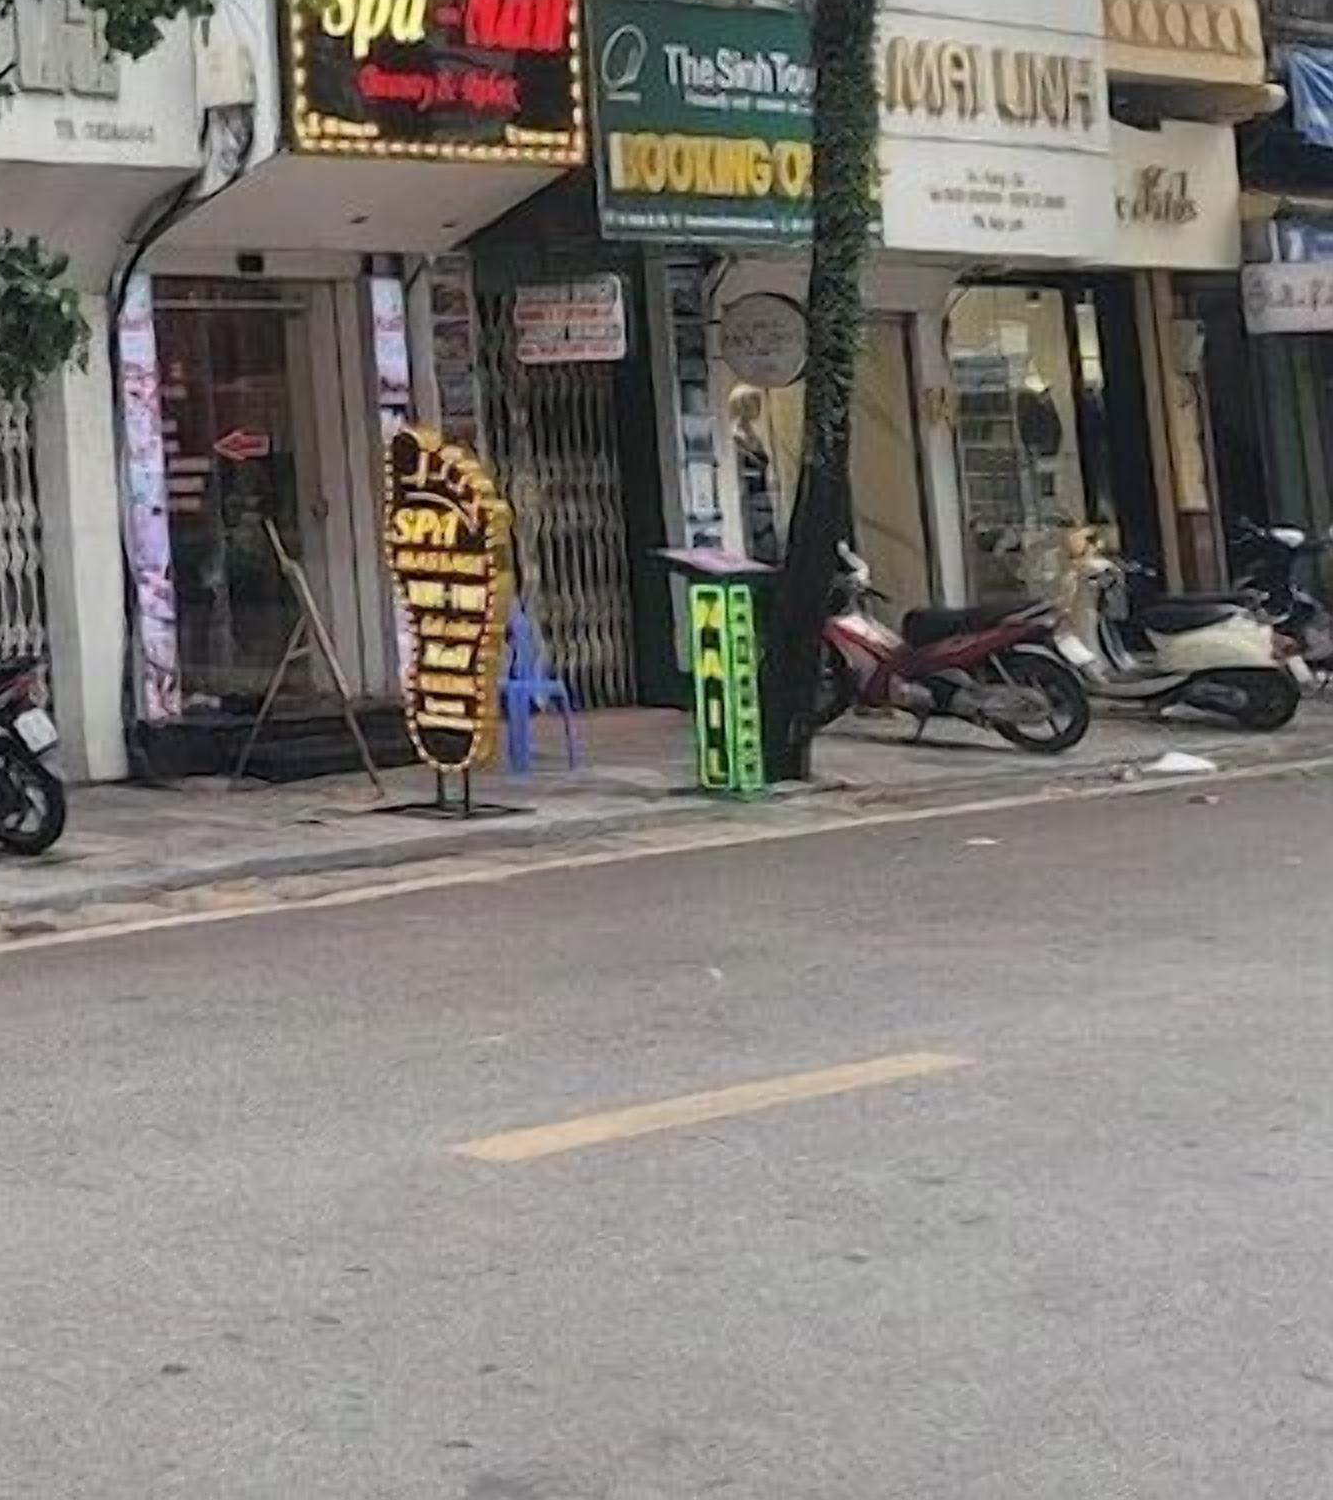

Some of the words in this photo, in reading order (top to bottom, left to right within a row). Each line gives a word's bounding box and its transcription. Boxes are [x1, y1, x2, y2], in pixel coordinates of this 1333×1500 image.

[885, 36, 984, 119] MAI
[609, 132, 772, 197] BOOKING
[393, 508, 459, 546] SPA
